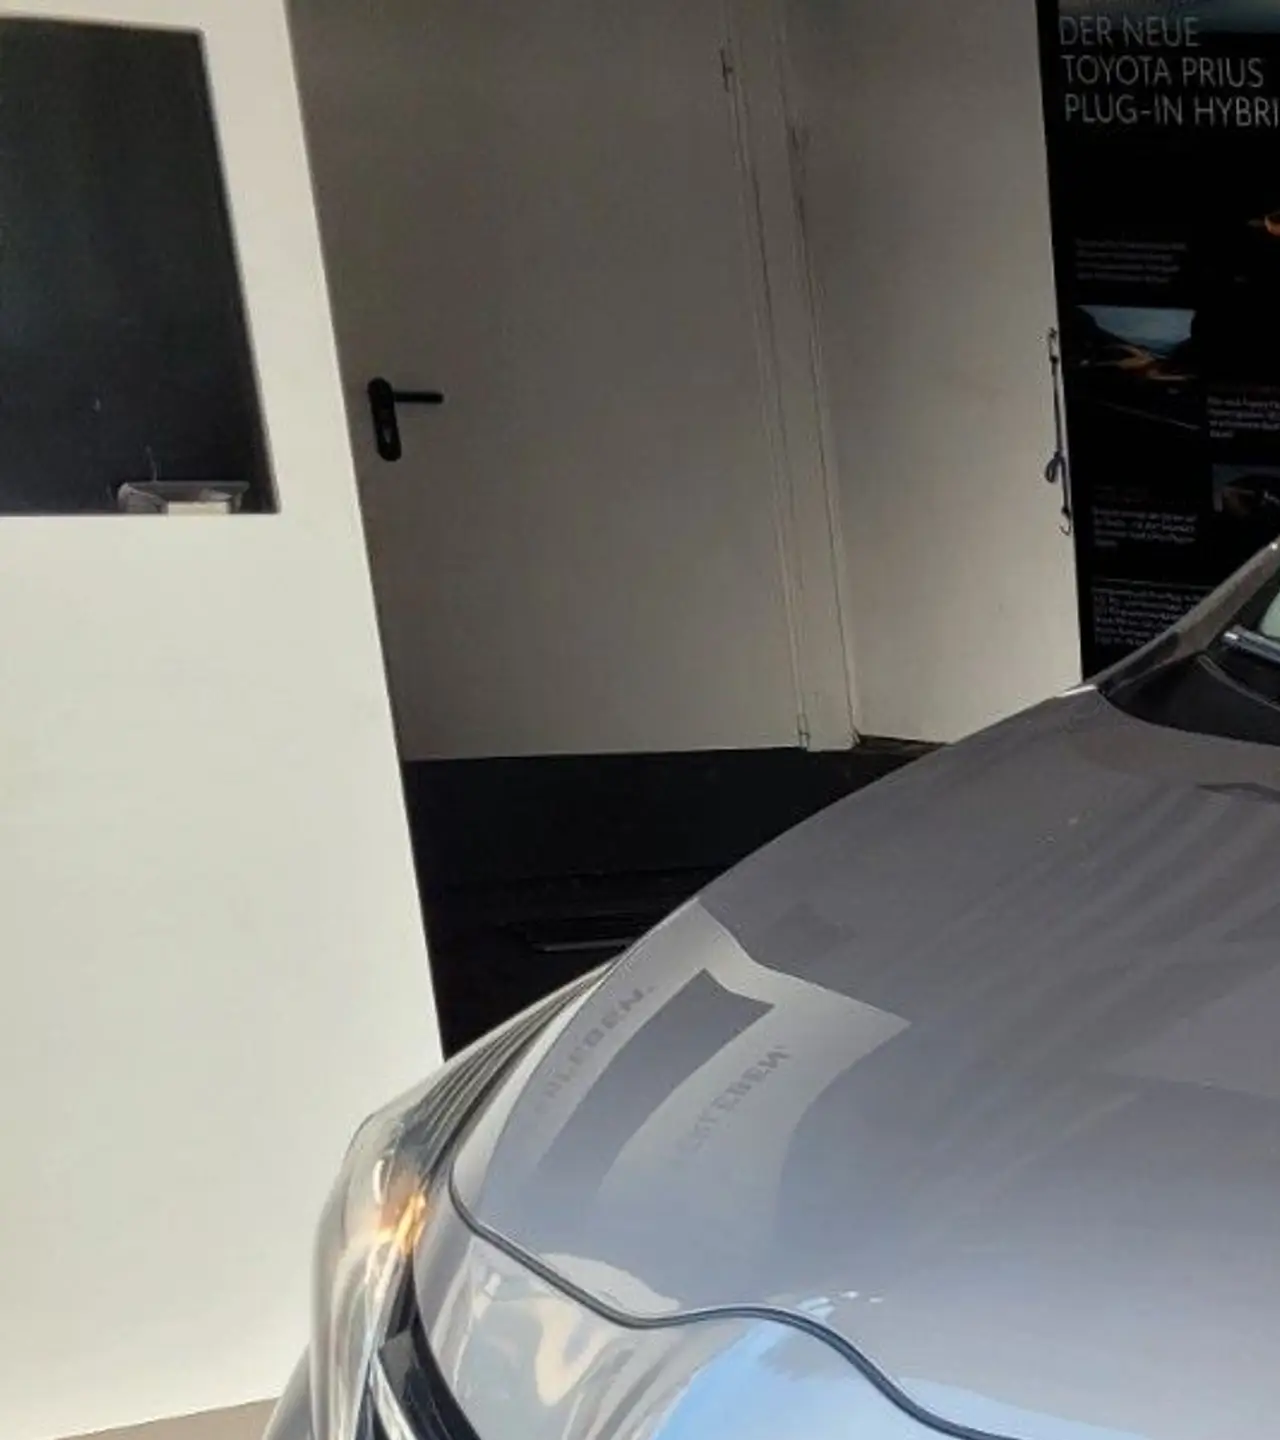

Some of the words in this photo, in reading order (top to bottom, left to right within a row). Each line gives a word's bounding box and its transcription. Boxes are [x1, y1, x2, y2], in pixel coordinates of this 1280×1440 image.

[1059, 16, 1112, 46] DER
[1124, 17, 1200, 48] NEUE
[1061, 55, 1172, 86] TOYOTA
[1182, 57, 1264, 88] PRIUS
[1065, 94, 1183, 124] PLUG-IN
